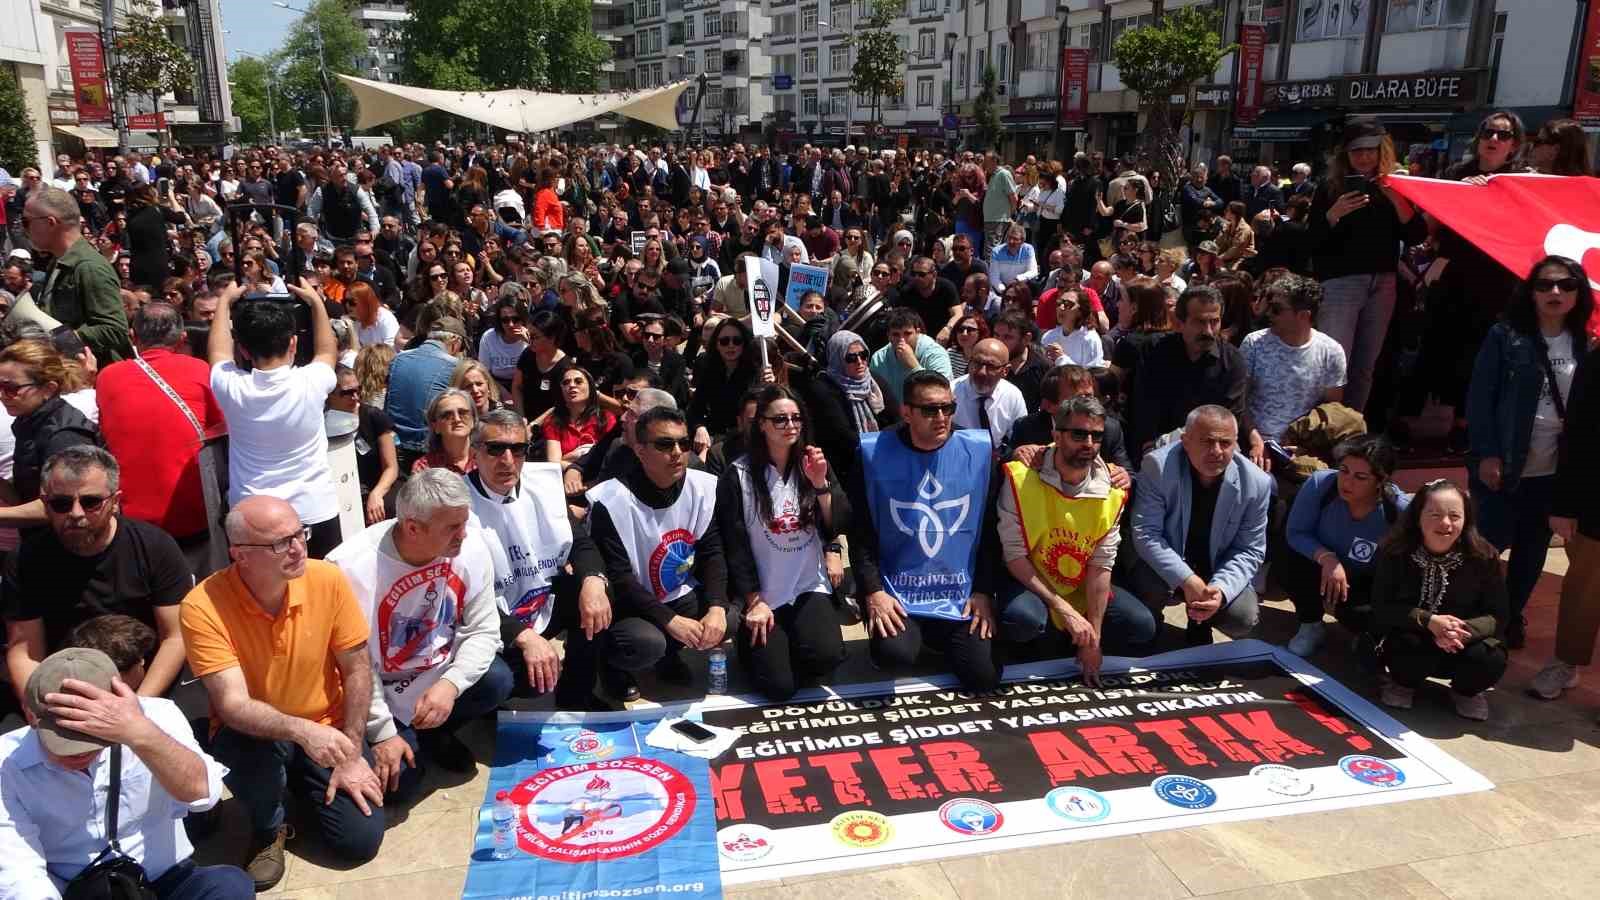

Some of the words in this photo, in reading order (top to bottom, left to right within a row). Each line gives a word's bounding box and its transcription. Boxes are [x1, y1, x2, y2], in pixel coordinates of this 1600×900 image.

[1413, 77, 1461, 97] BÜFE
[883, 702, 983, 723] ŞİDDET
[989, 692, 1090, 711] YASASI
[736, 731, 884, 760] EĞİTİMDE
[890, 719, 993, 745] ŞİDDET
[999, 702, 1134, 730] YASASINI
[1137, 691, 1265, 717] ÇIKARTIN
[524, 762, 590, 793] EĞİTİM
[709, 740, 1004, 821] YETER
[1027, 710, 1325, 787] ARTIK
